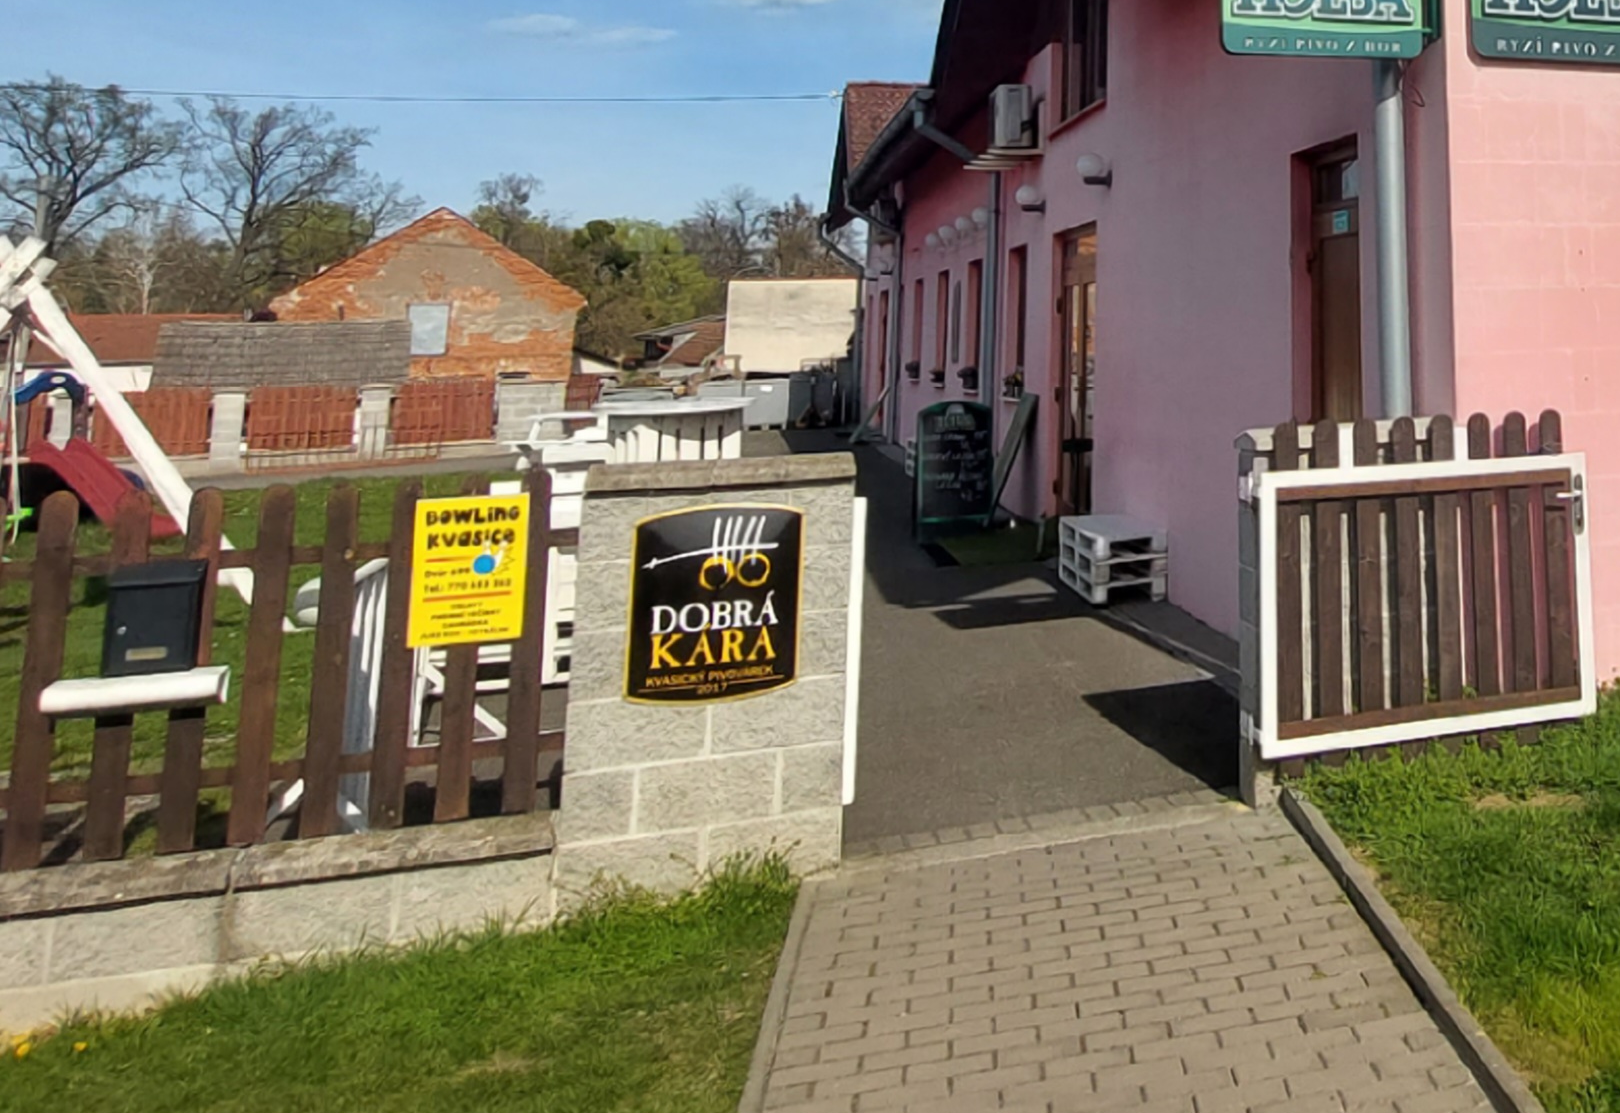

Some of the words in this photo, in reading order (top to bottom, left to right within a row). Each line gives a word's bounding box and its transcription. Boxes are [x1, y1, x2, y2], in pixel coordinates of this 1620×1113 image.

[1551, 41, 1597, 56] PIVO
[650, 589, 779, 635] DOBRÁ
[650, 622, 776, 670] KÁRA
[696, 681, 729, 695] 2017
